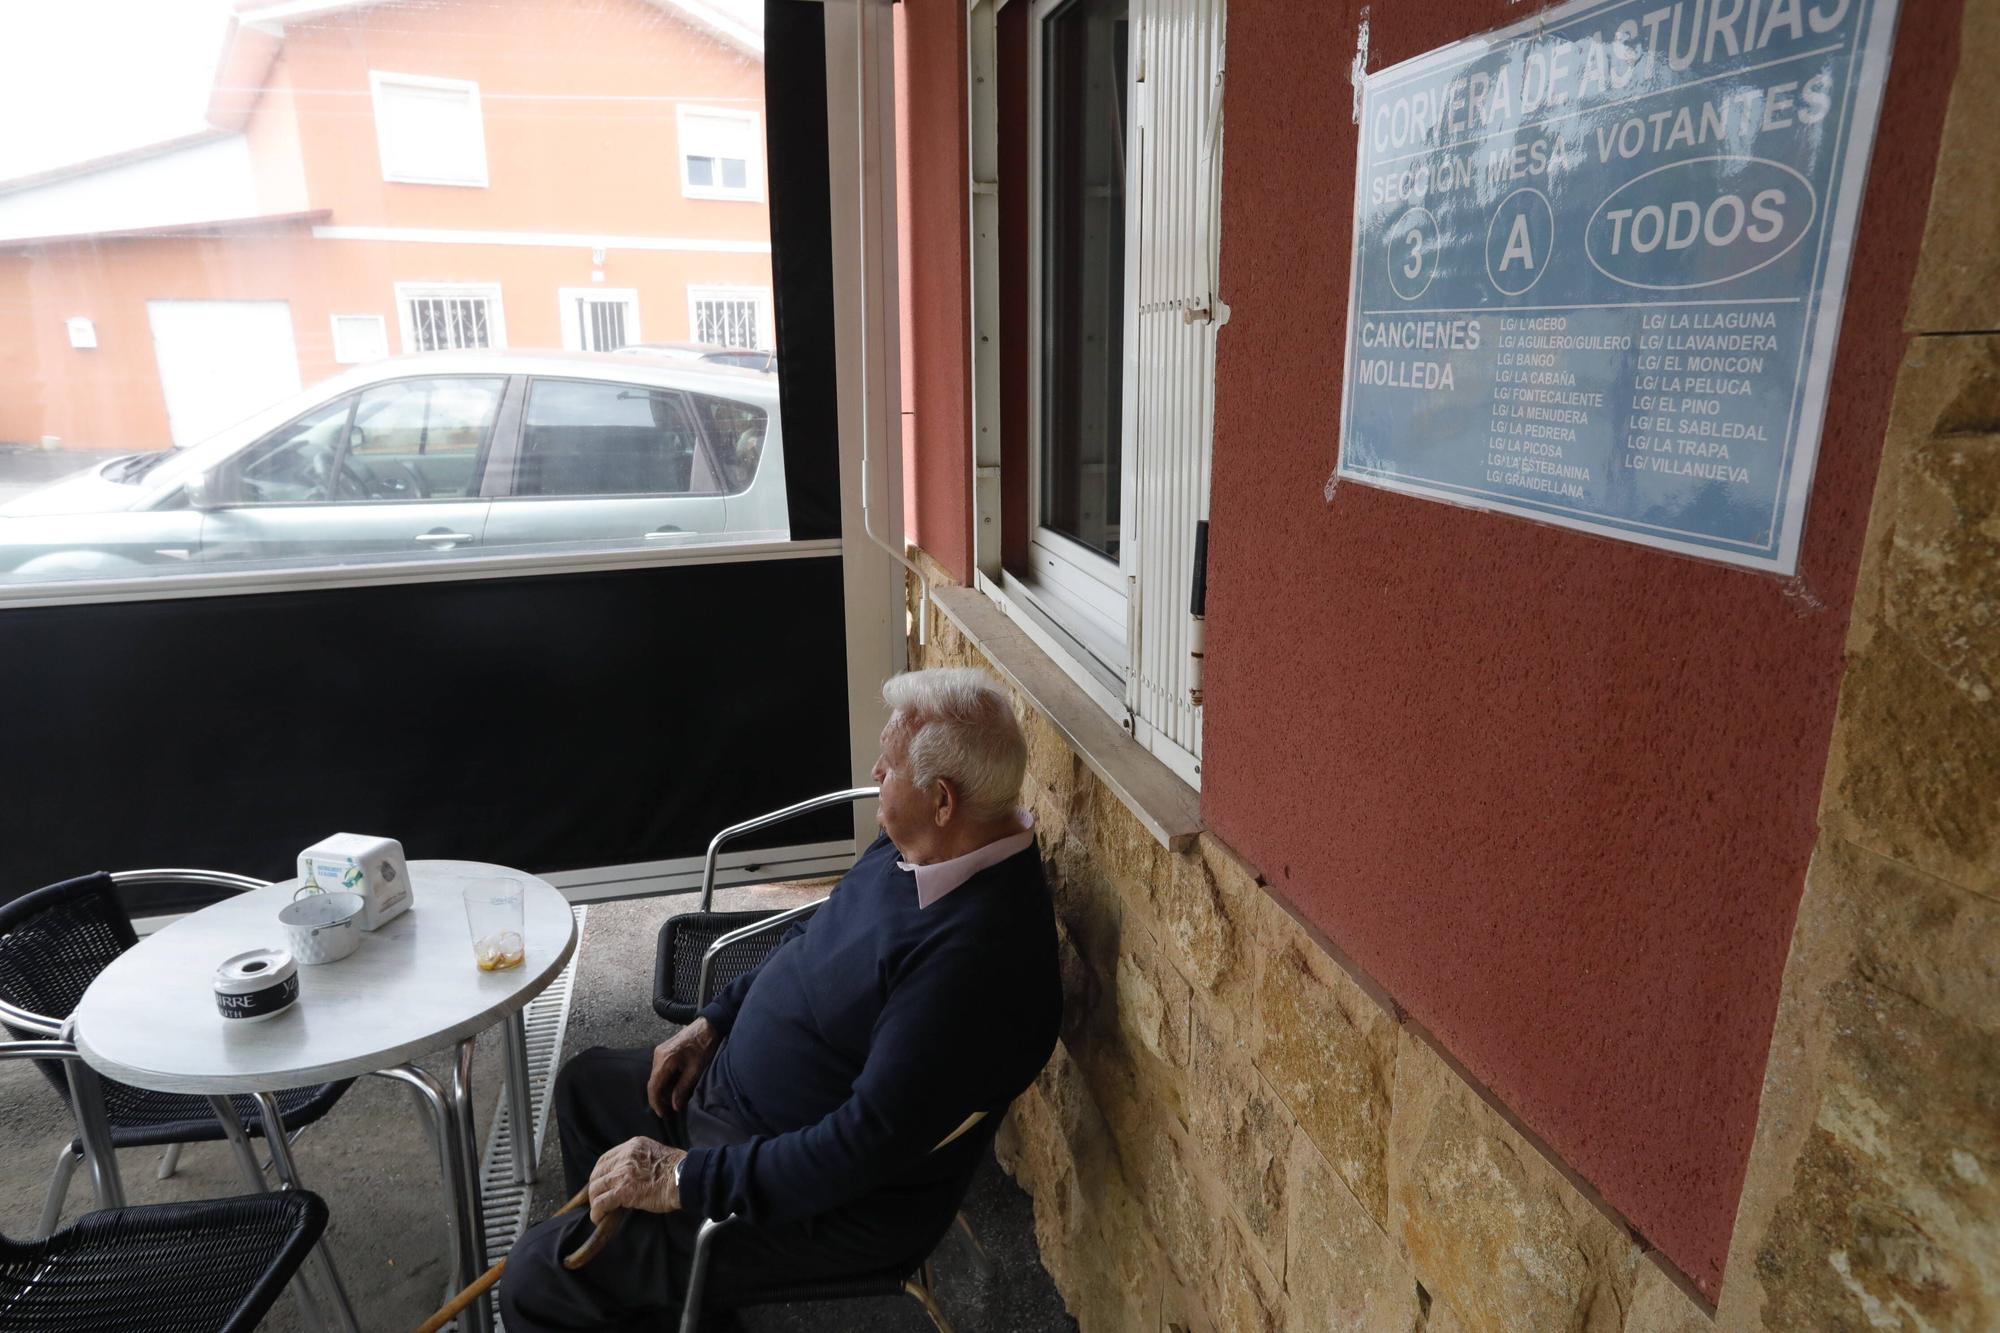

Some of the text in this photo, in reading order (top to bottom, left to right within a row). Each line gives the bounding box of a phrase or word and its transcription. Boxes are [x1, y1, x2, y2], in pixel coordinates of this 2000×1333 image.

[1373, 65, 1512, 153] CORVERA
[1520, 44, 1572, 114] DE
[1371, 73, 1833, 204] SECCIÓN MESA VOTANTES
[1403, 188, 1788, 279] 3 A TODOS
[1500, 317, 1567, 331] LG/ L'ACEBO
[1642, 311, 1777, 329] LG/ LA LLAGUNA
[1362, 320, 1481, 350] CANCIENES
[1498, 335, 1632, 350] LG/ AGUILERO/GUILERO
[1639, 334, 1777, 351] LG/ LLAVANDERA
[1497, 353, 1555, 367] LG/ BANGO
[1637, 355, 1764, 374] LG/ EL MONCON
[1359, 359, 1455, 391] MOLLEDA
[1495, 370, 1576, 387] LG/ LA CABAÑA
[1634, 375, 1752, 395] LG/ LA PELUCA
[1493, 387, 1603, 408] LG/ FONTECALIENTE
[1631, 395, 1721, 416] LG/ EL PINO
[1492, 403, 1589, 425] LG/ LA MENUDERA
[1490, 420, 1577, 442] LG/ LA PEDRERA
[1629, 415, 1768, 442] LG/ EL SABLEDAL
[1489, 437, 1563, 459] LG/ LA PICOSA
[1627, 434, 1730, 460] LG/ LA TRAPA
[1487, 453, 1505, 466] LG/
[1521, 458, 1591, 481] ESTEBANINA
[1624, 453, 1750, 484] LG/ VILLANUEVA
[1486, 470, 1585, 499] LG/ GRANDELLANA
